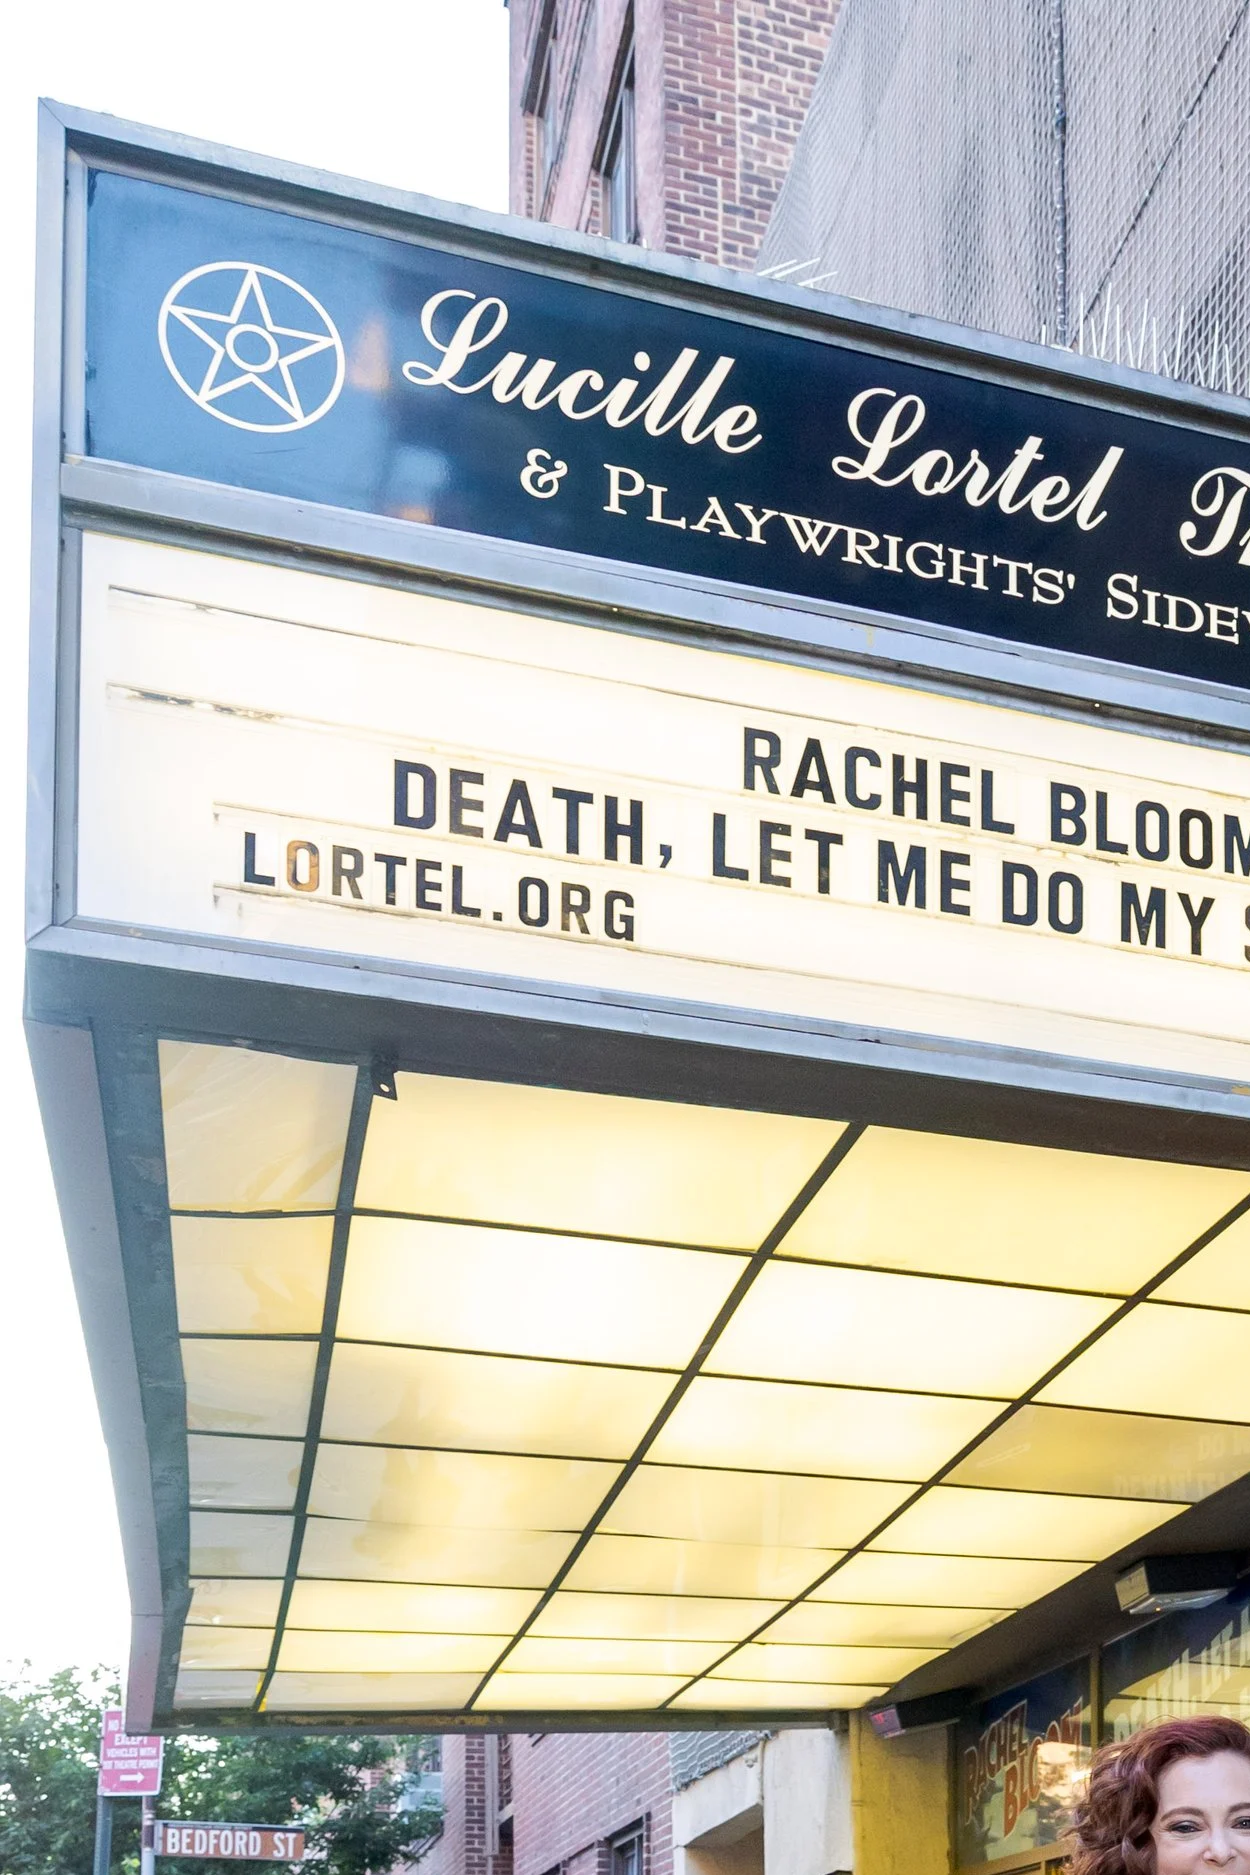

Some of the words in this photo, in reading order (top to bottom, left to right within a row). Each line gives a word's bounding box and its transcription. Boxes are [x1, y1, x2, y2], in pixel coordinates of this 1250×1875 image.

[401, 288, 763, 454] Lucille
[831, 387, 1125, 532] Lortel
[520, 448, 568, 499] &
[744, 726, 1015, 836] RACHEL
[242, 831, 636, 943] LORTEL.ORG
[393, 758, 674, 869] DEATH,
[712, 812, 844, 895] LET
[877, 840, 972, 917] ME
[1001, 861, 1084, 936] DO
[1120, 882, 1215, 956] MY
[166, 1828, 261, 1857] BEDFORD
[273, 1833, 297, 1858] ST
